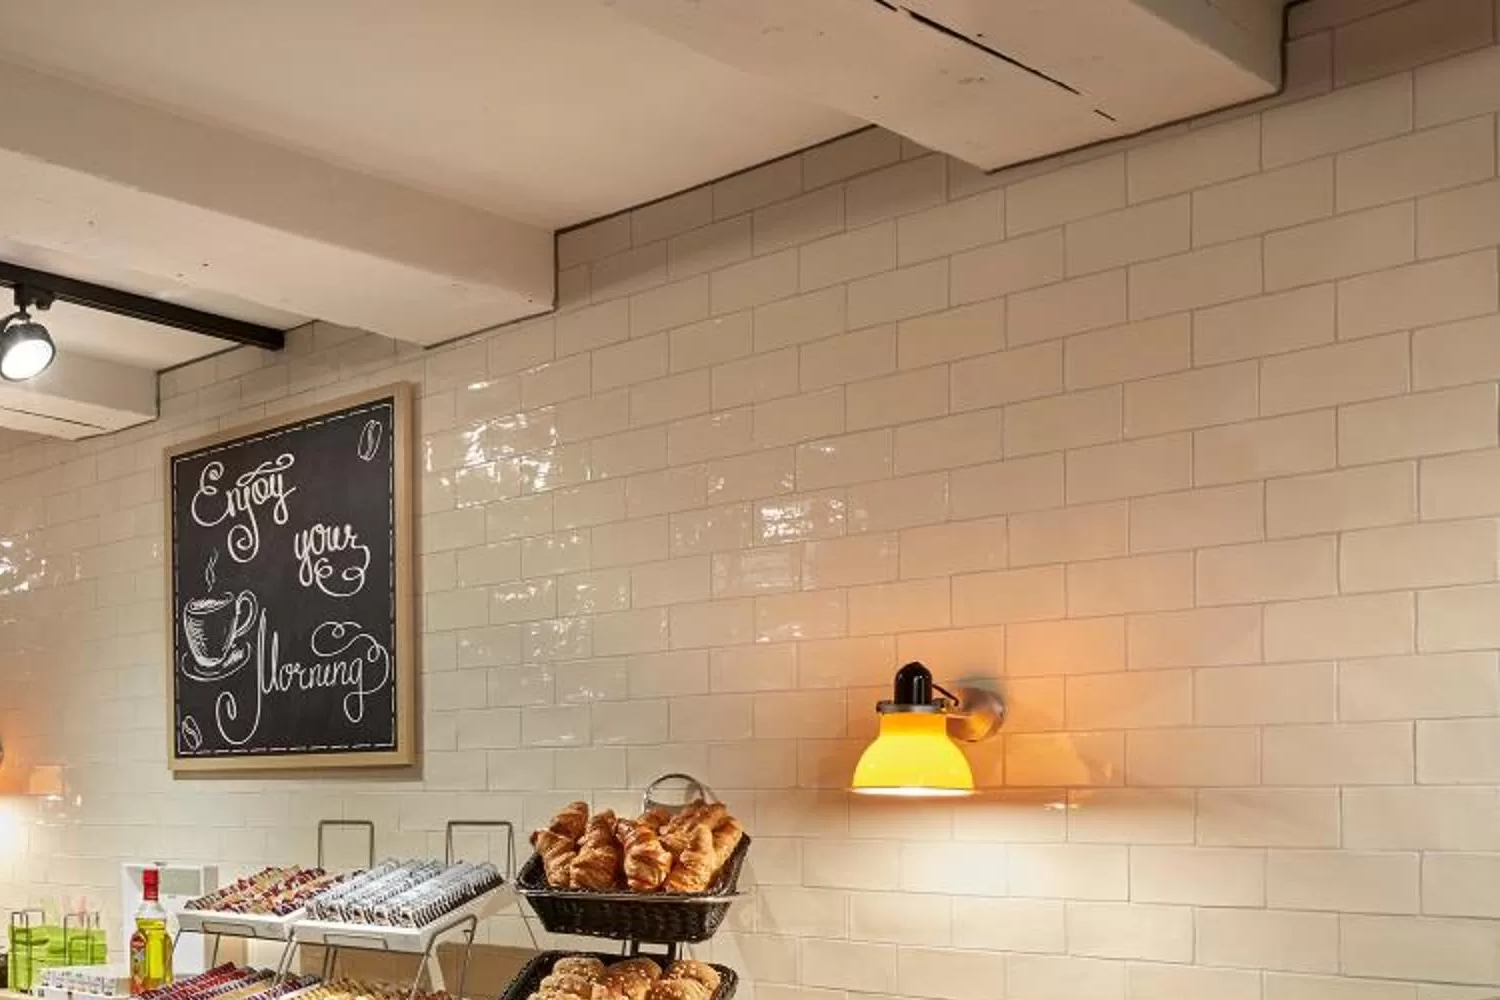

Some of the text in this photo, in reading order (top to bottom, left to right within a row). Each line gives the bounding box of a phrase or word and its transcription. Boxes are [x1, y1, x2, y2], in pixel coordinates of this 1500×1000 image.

[191, 453, 297, 563] Enjoy
[294, 523, 371, 597] your
[215, 607, 390, 745] Morning
